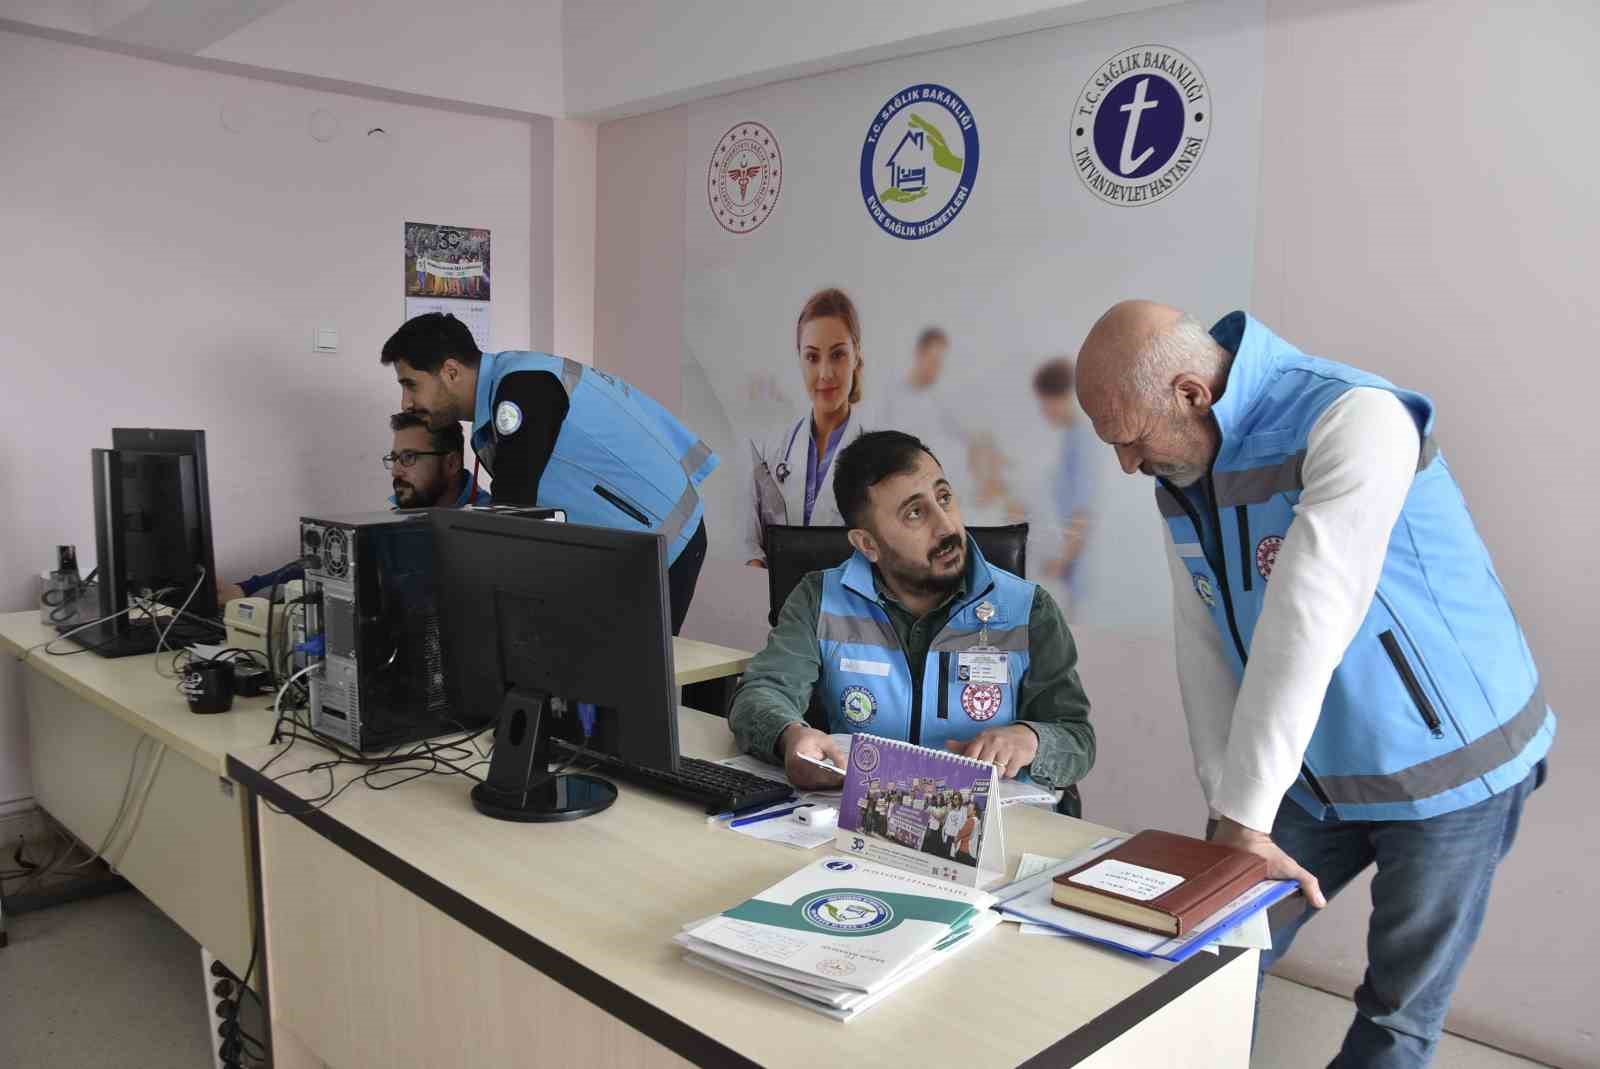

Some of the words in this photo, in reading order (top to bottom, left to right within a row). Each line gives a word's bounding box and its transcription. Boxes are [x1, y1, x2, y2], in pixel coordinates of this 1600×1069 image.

[1095, 52, 1141, 92] SAĞLIK
[1143, 51, 1204, 104] BAKANLIĞI
[881, 89, 920, 119] SAĞLIK
[922, 88, 973, 131] BAKANLIĞI
[1075, 146, 1110, 192] TATVAN
[1103, 180, 1149, 202] DEVLET
[1149, 136, 1204, 198] HASTANESİ
[867, 195, 884, 222] EVDE
[884, 217, 917, 237] SAĞLIK
[918, 186, 969, 236] HİZMETLERİ
